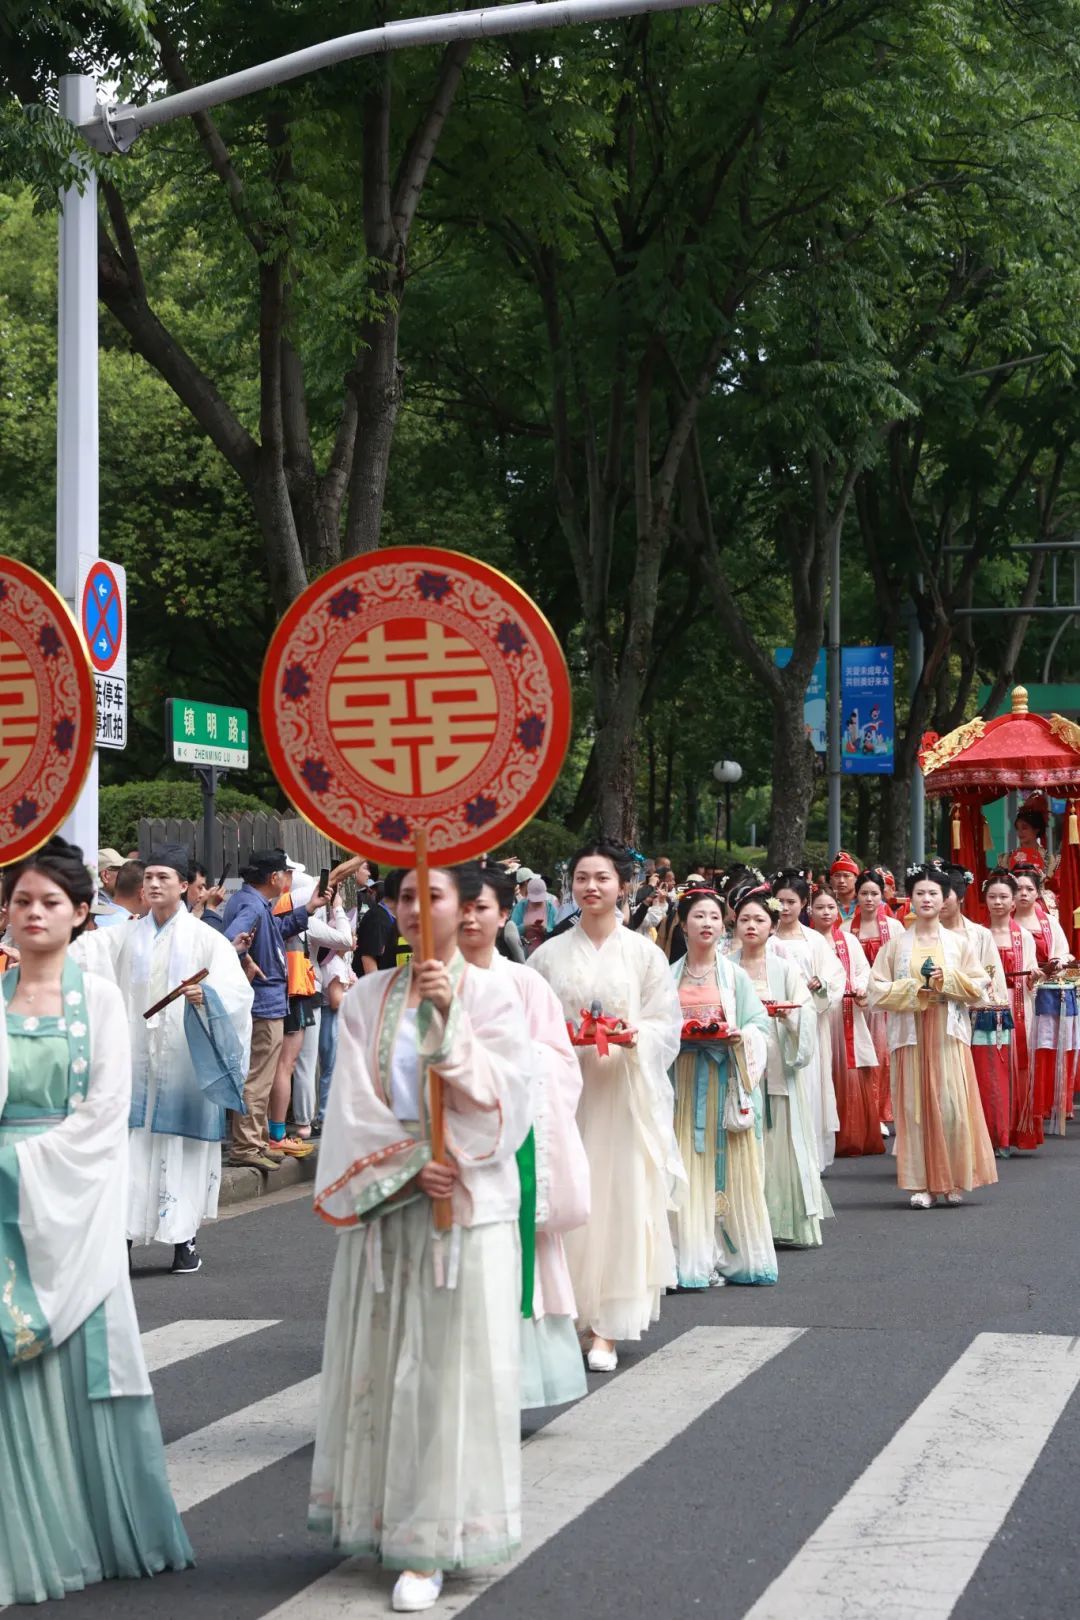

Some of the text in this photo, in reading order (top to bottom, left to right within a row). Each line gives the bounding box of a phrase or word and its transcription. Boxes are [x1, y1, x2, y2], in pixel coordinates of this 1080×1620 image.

[184, 707, 239, 743] 镇明路
[194, 748, 231, 763] ZHENMING LU
